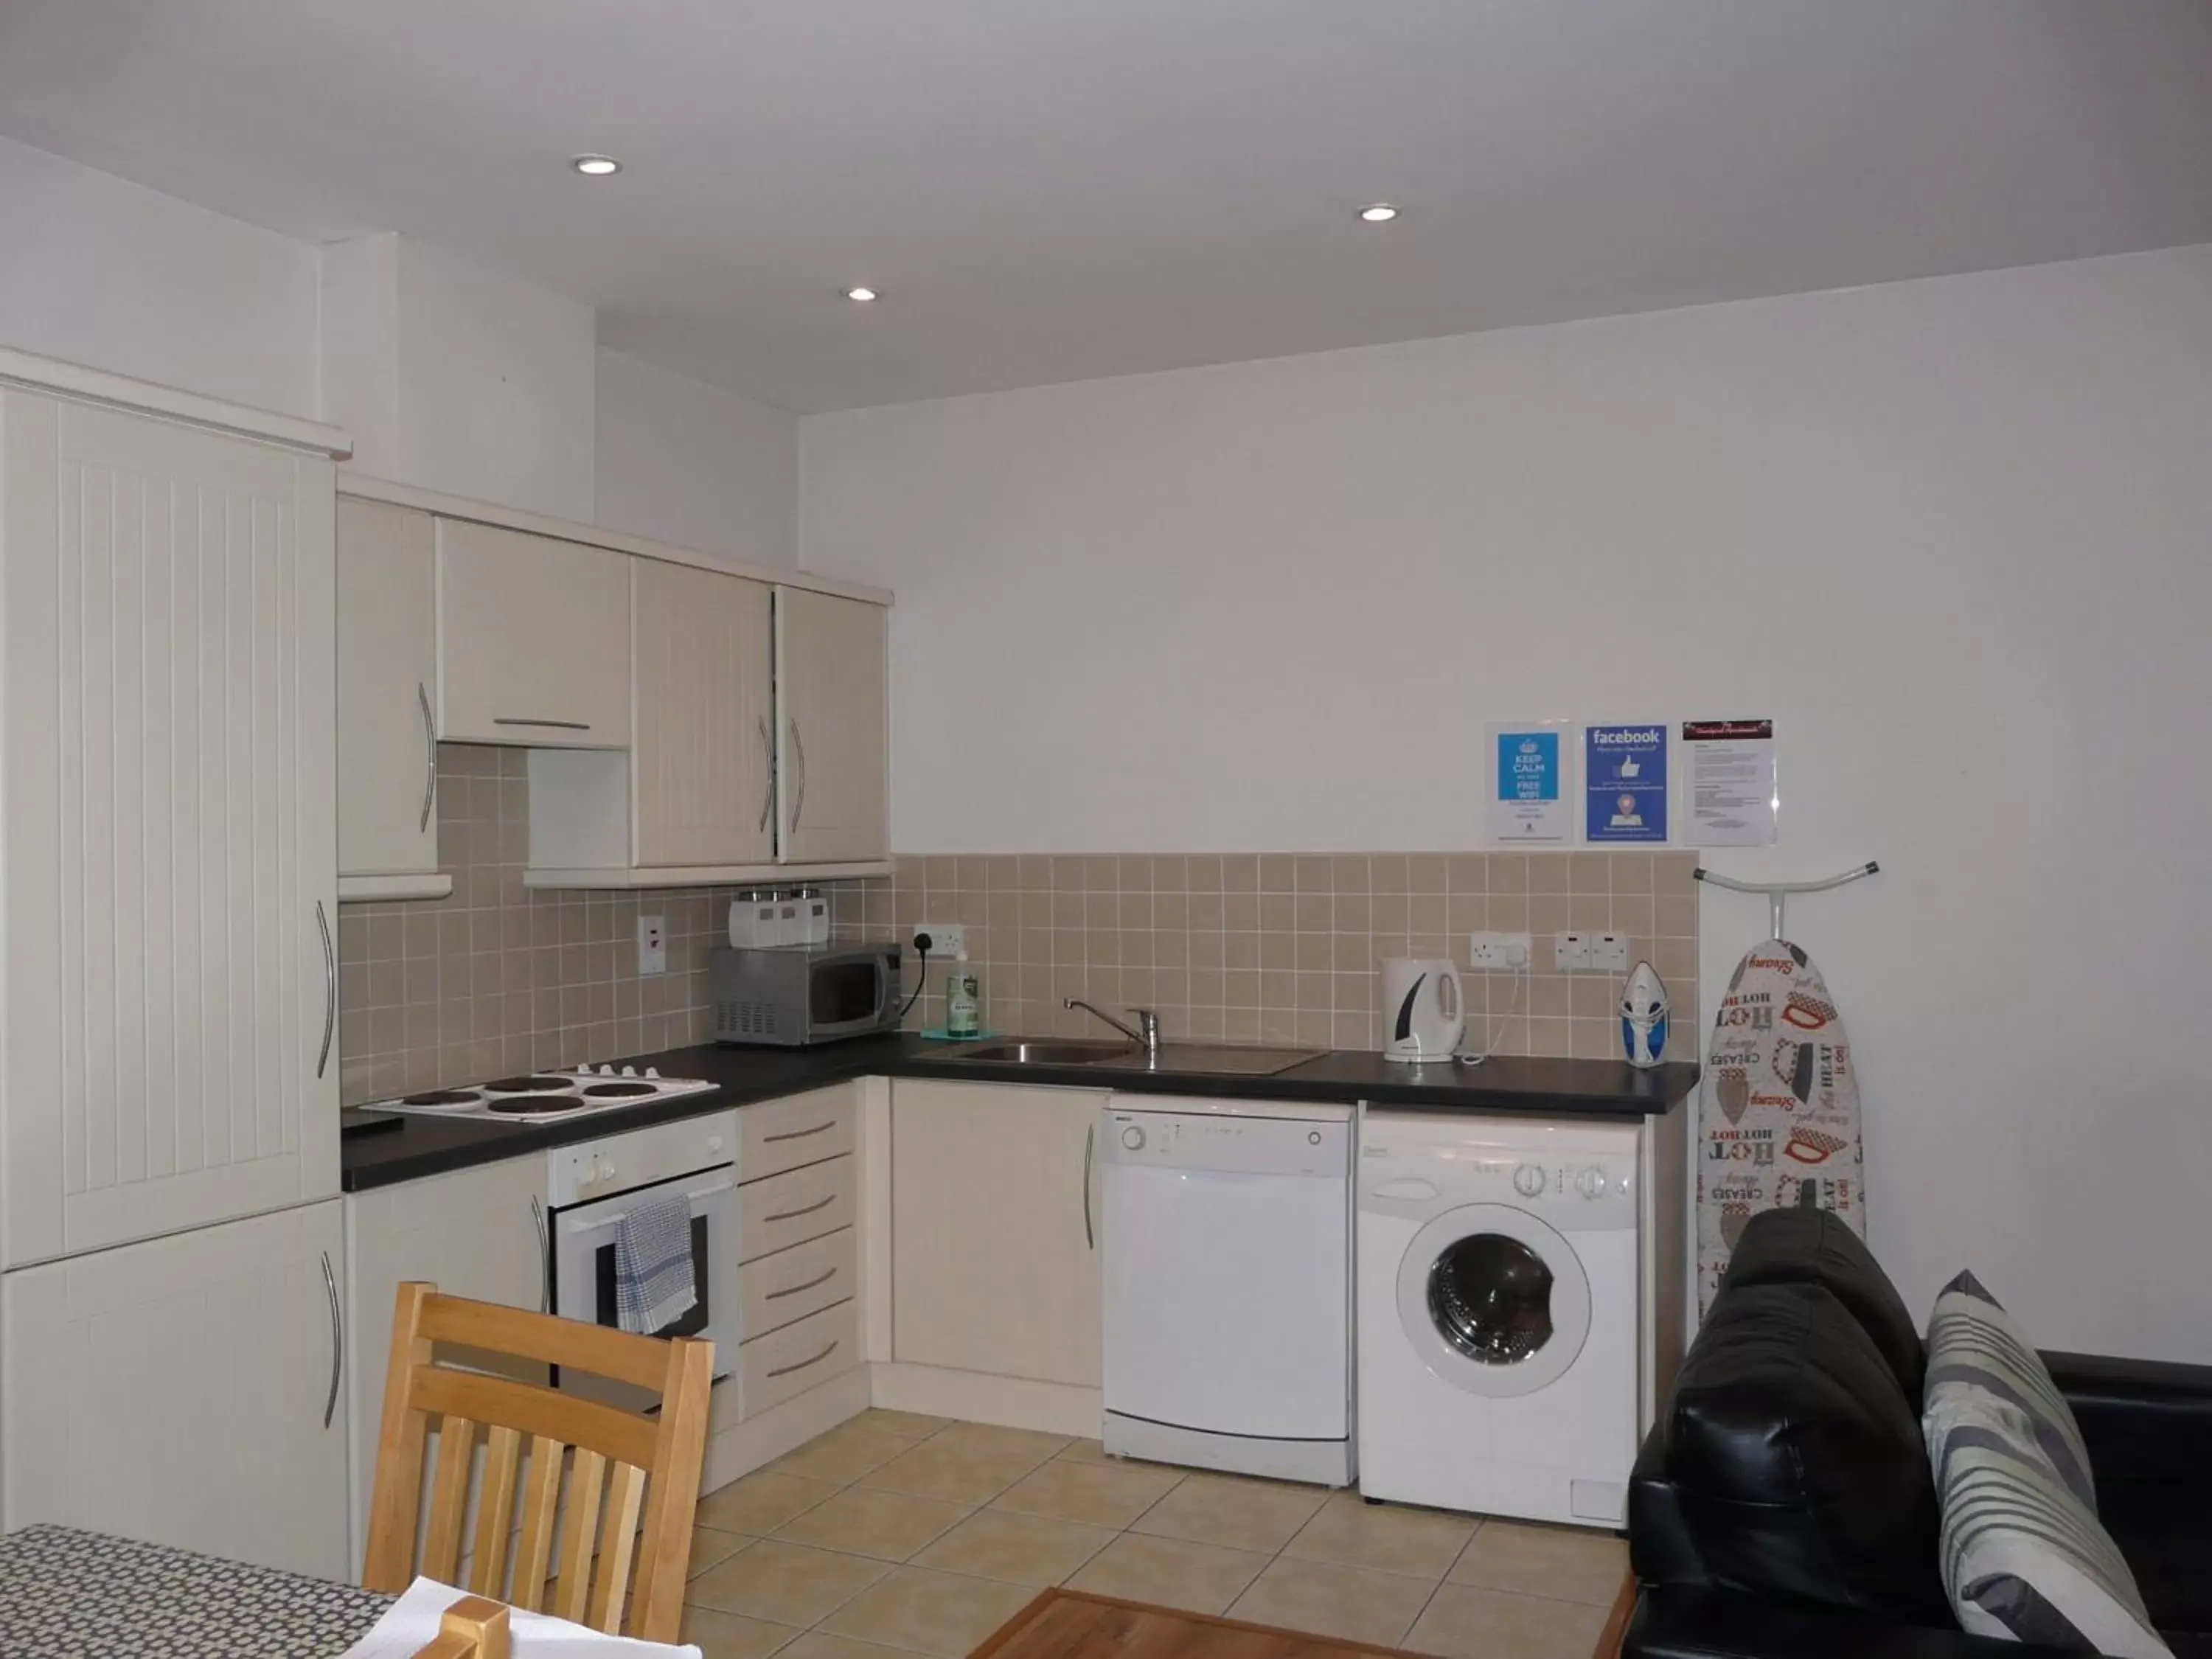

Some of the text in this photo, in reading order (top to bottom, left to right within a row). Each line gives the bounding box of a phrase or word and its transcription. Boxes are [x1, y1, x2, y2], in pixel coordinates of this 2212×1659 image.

[1594, 728, 1659, 743] facebook
[1515, 754, 1543, 763] KEEP
[1512, 764, 1545, 773] CALM
[1517, 781, 1540, 790] FREE
[1748, 954, 1794, 974] Steamy
[1743, 992, 1770, 1004] HOT
[1711, 1052, 1760, 1065] CREASES
[1820, 1043, 1833, 1088] HEAT
[1750, 1091, 1796, 1111] Steamy
[1710, 1130, 1773, 1140] HOT HOT
[1708, 1141, 1775, 1167] HOT
[1711, 1187, 1764, 1200] CREASES
[1824, 1178, 1835, 1211] EAT
